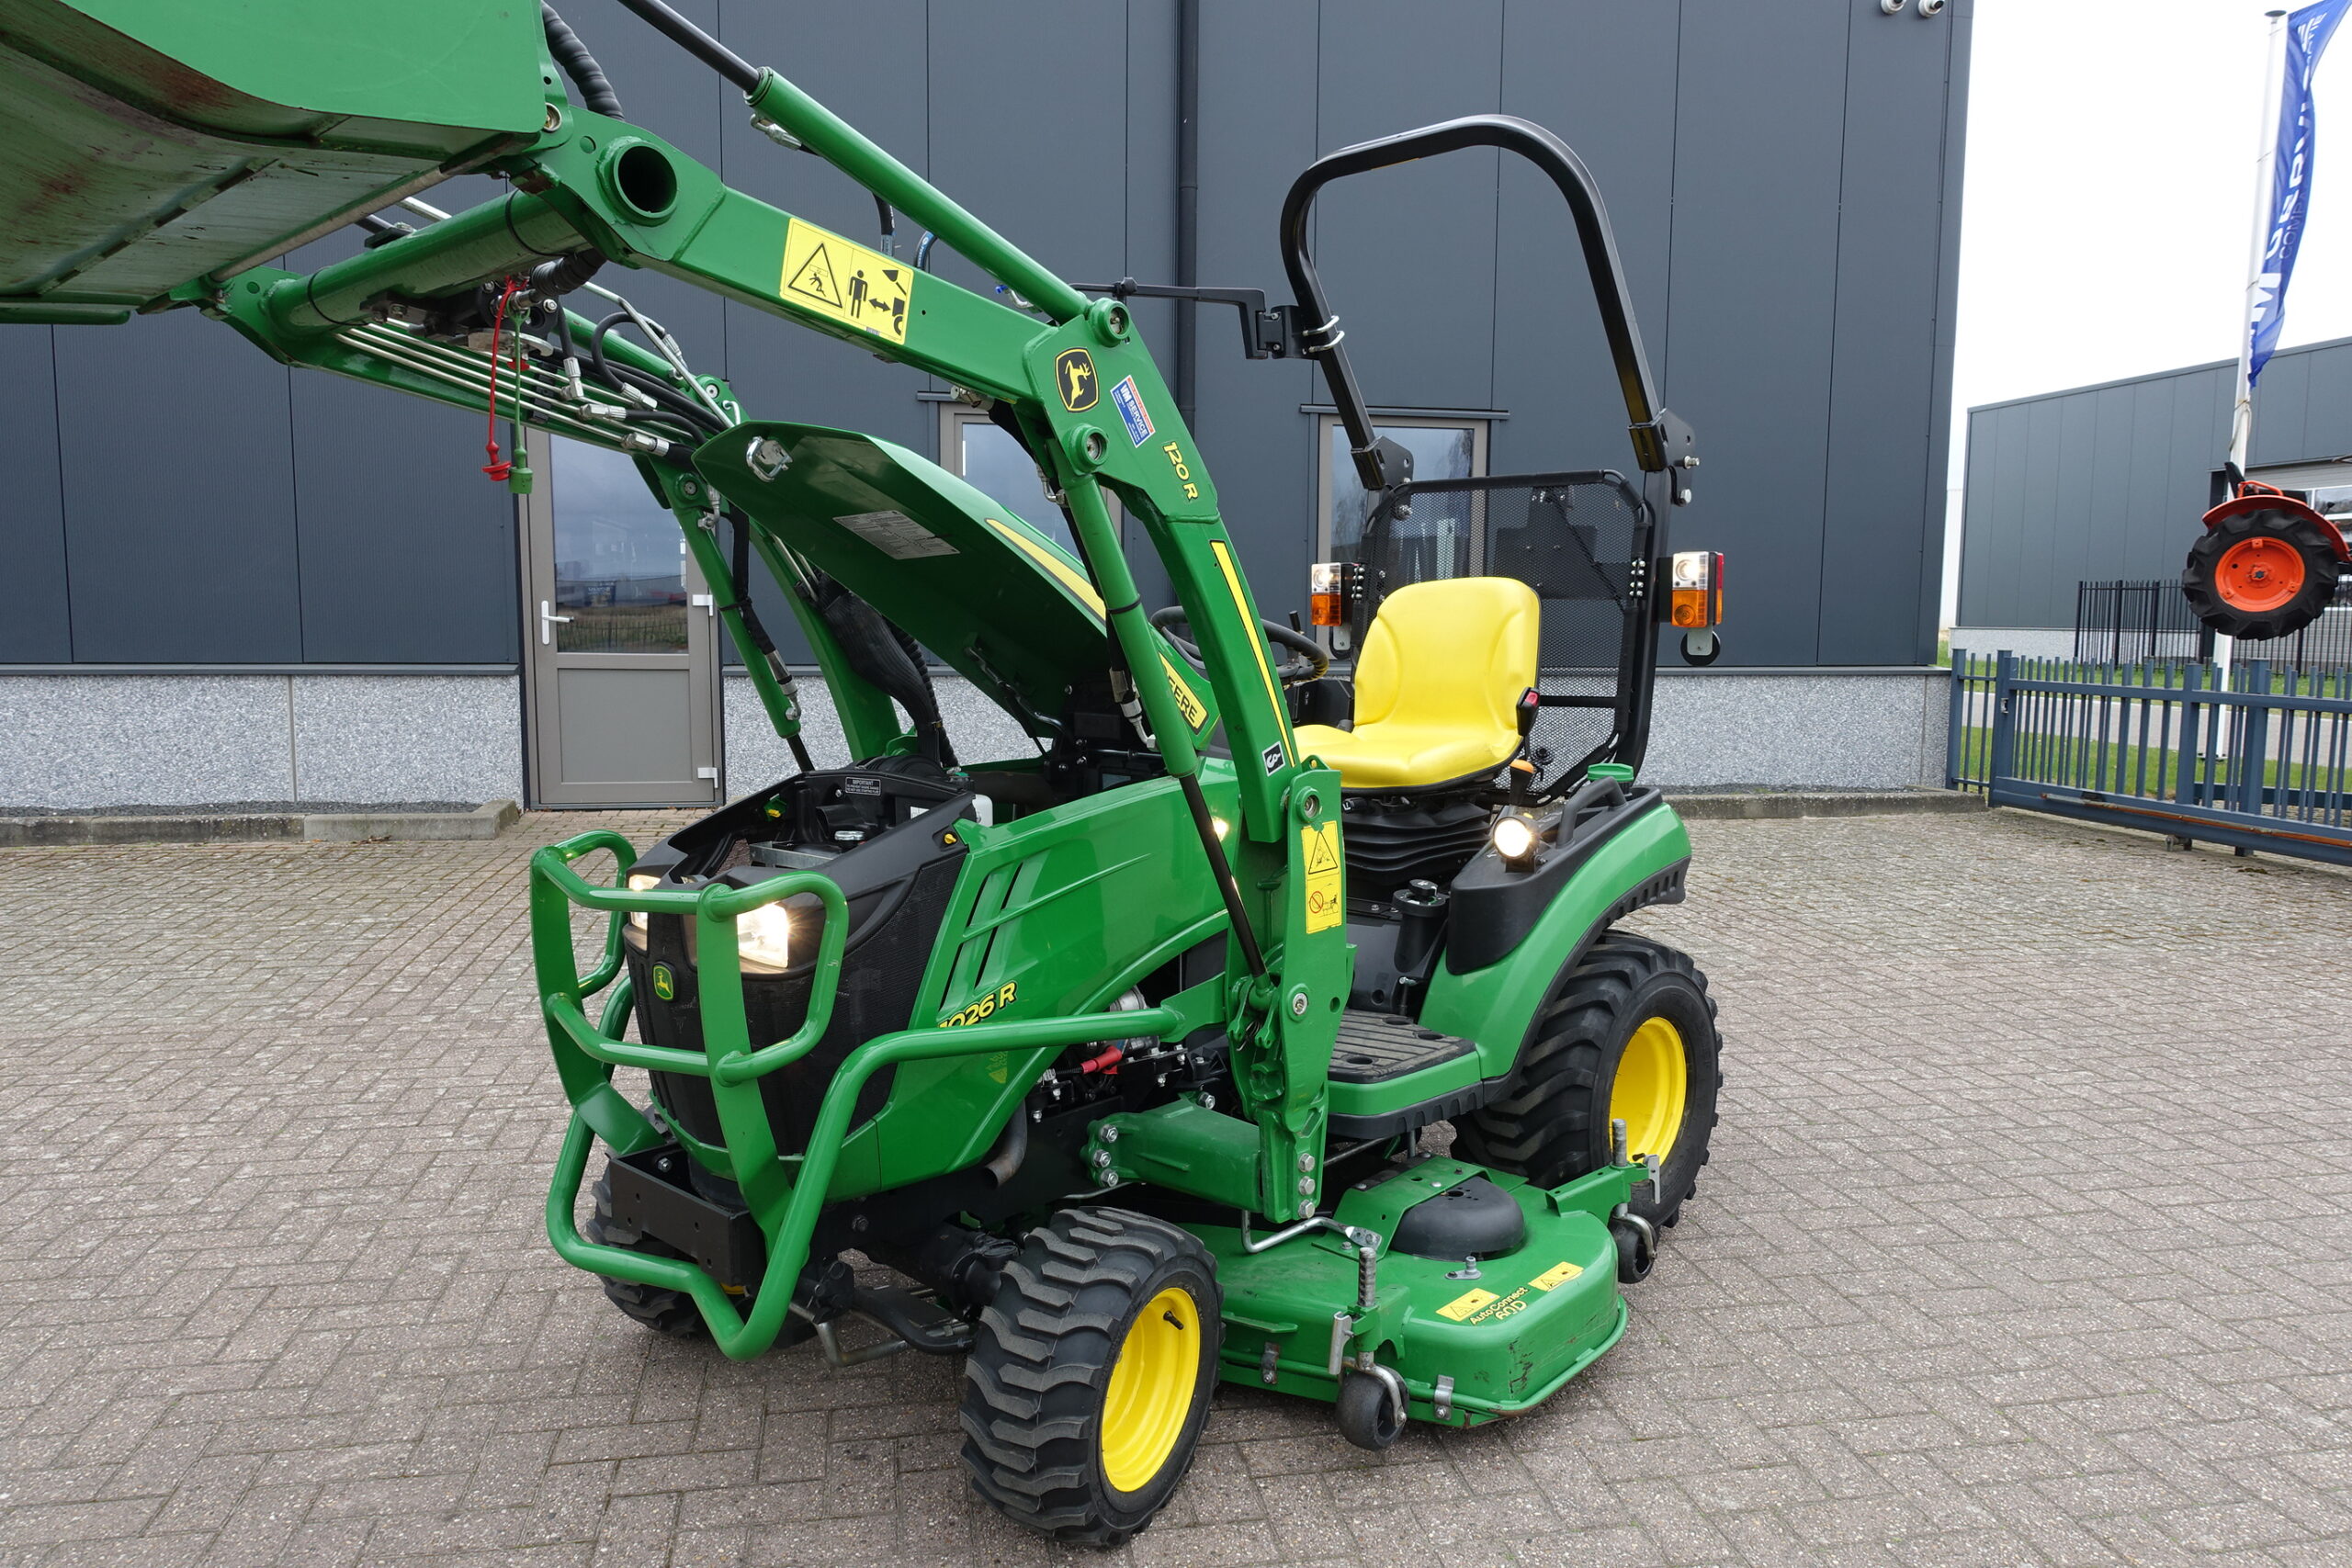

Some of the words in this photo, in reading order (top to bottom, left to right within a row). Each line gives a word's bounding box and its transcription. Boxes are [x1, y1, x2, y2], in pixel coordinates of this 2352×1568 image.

[1128, 399, 1148, 439] SERVICE
[1163, 441, 1190, 481] 120
[1182, 482, 1199, 502] R
[999, 981, 1017, 1010] R
[1469, 1286, 1529, 1325] AutoConnect
